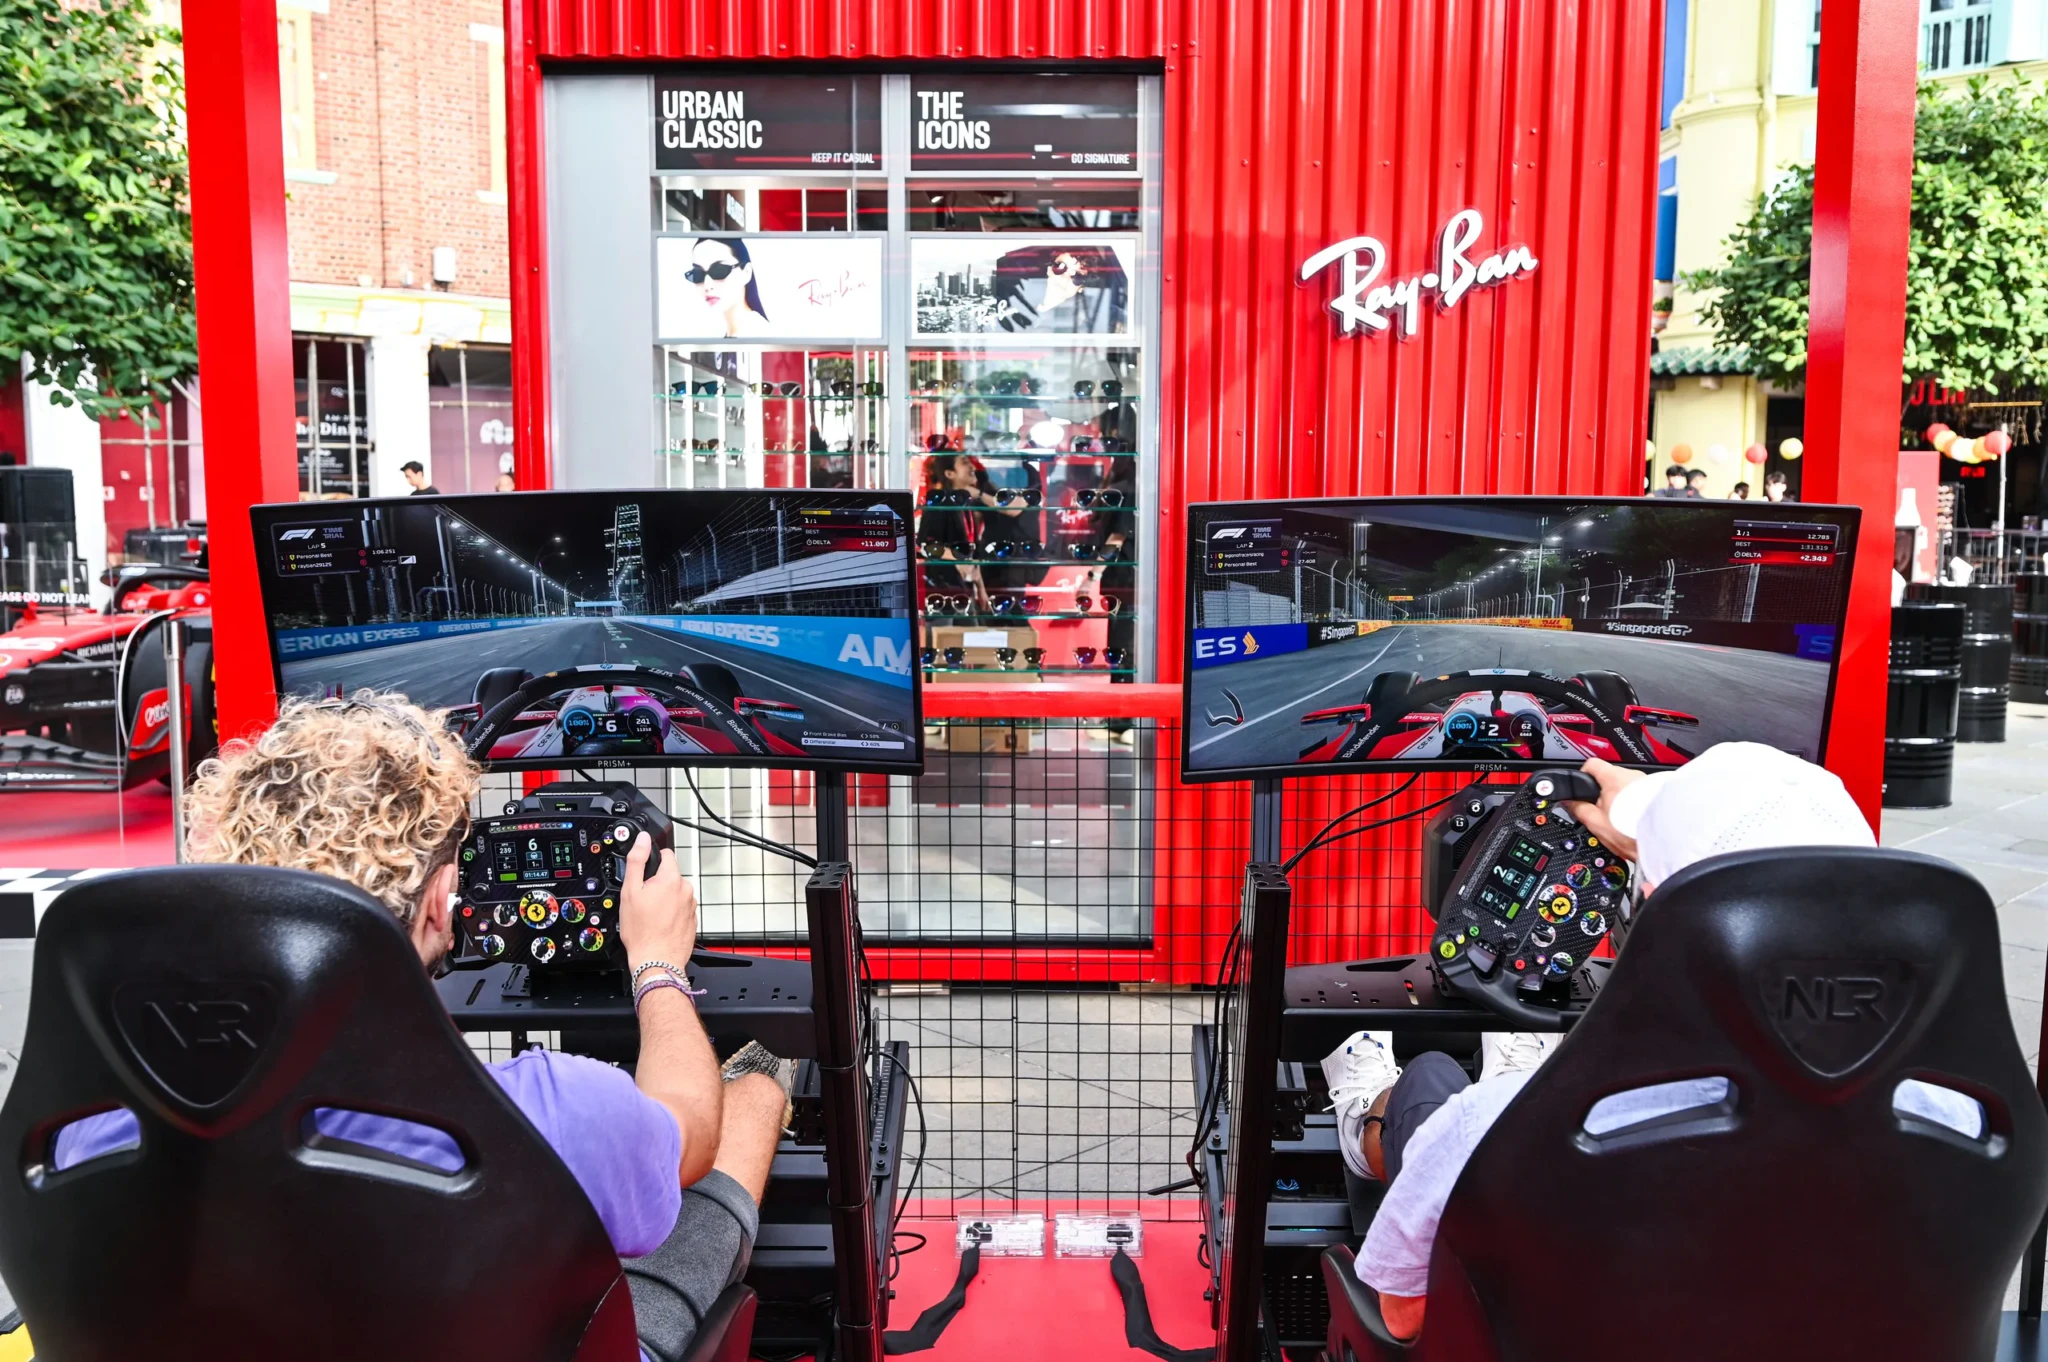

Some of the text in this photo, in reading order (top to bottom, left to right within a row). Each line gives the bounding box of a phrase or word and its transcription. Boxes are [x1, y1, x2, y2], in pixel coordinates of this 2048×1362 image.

[662, 90, 744, 119] URBAN
[917, 91, 964, 119] THE
[663, 120, 763, 149] CLASSIC
[918, 120, 991, 150] ICONS
[811, 153, 875, 164] KEEP IT CASUAL
[1071, 153, 1130, 164] GO SIGNATURE
[0, 592, 21, 602] ASE
[23, 592, 40, 602] DO
[41, 592, 65, 603] NOT
[278, 626, 420, 653] ERICAN EXPRESS
[714, 621, 780, 648] EXPRESS
[1196, 636, 1237, 659] ES
[675, 685, 704, 702] RICHARD
[702, 700, 724, 717] MILLE
[1565, 691, 1611, 724] RICHARD MILLE
[606, 720, 617, 732] 6
[726, 719, 765, 755] Bitdefender
[1488, 724, 1499, 736] 2
[1342, 724, 1381, 759] Bitdefender
[1613, 726, 1648, 763] Bitdefender
[597, 760, 632, 768] PRISM+
[528, 838, 538, 851] 6
[1493, 865, 1507, 878] 2
